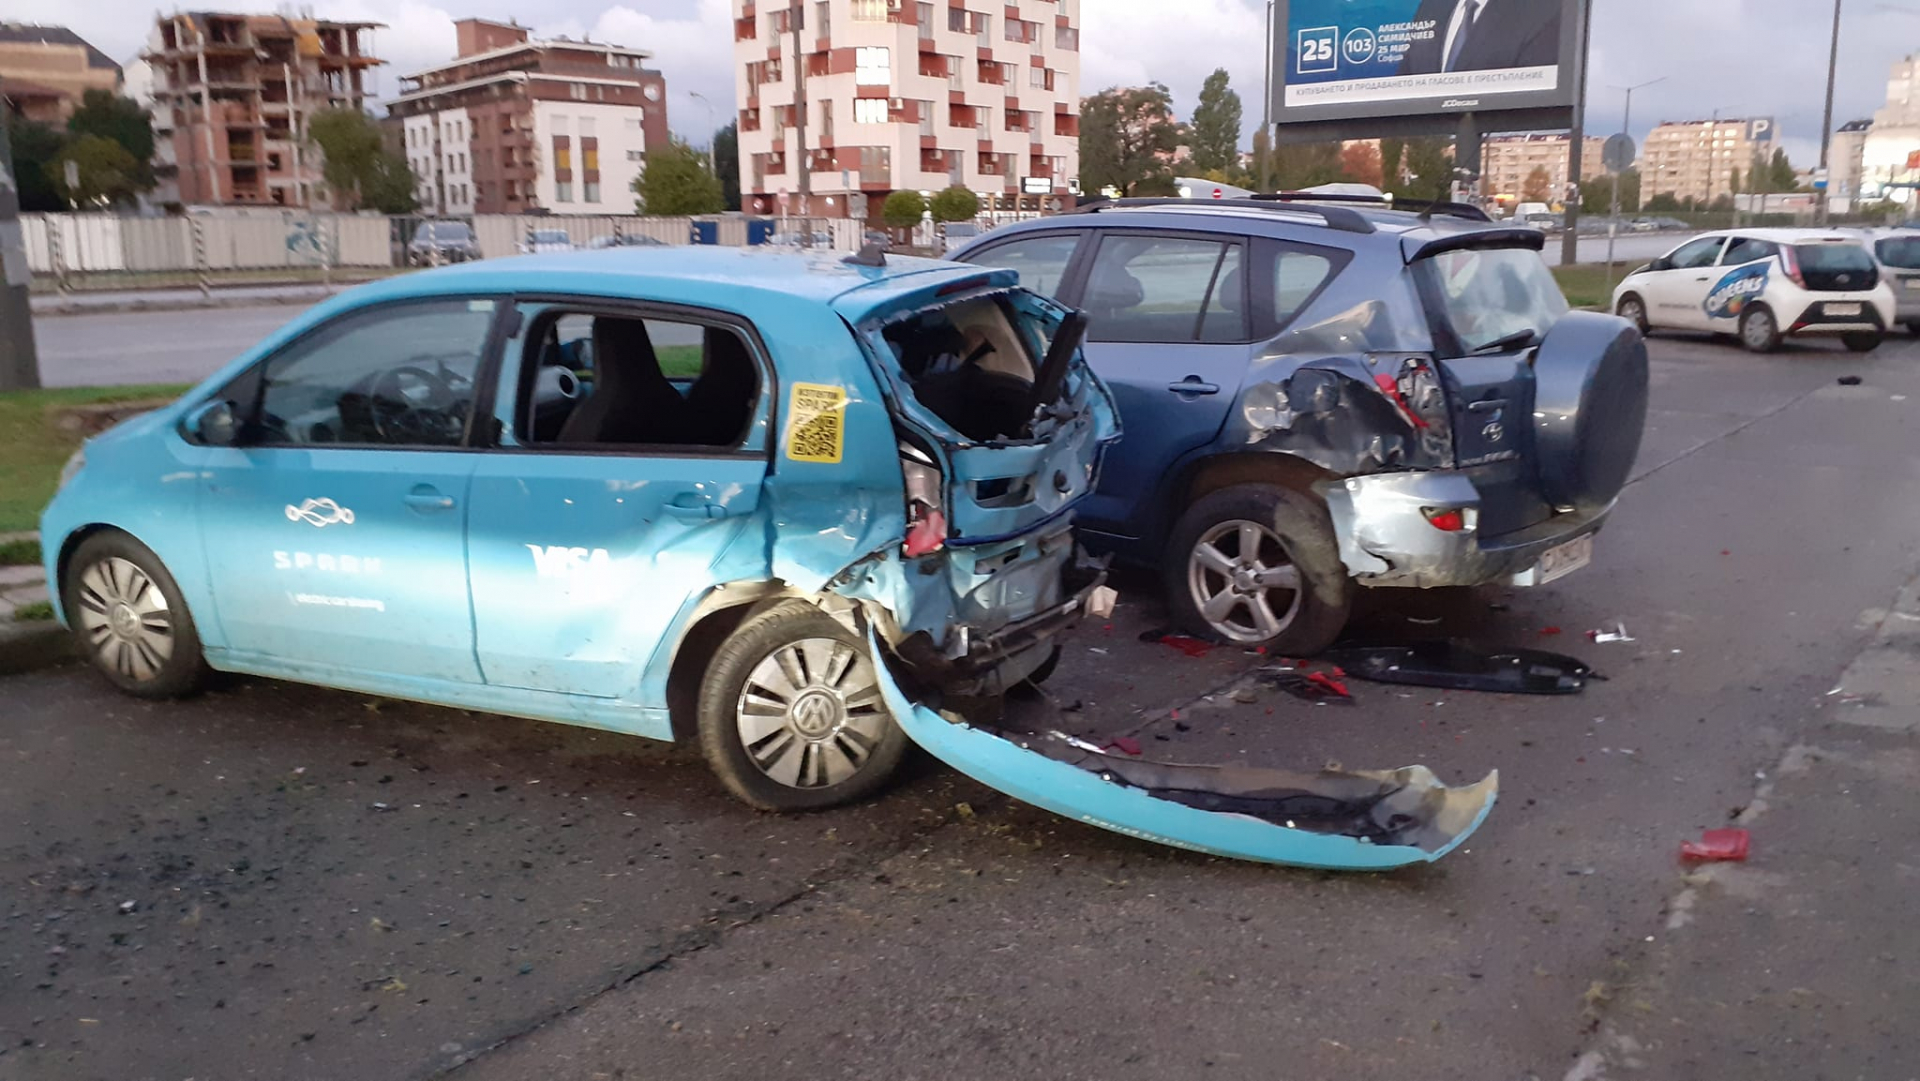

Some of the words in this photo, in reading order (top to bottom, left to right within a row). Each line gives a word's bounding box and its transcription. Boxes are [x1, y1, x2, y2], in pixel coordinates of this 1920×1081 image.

[1378, 20, 1436, 33] АЛЕКСАНДЪР
[1302, 38, 1332, 61] 25
[1346, 38, 1372, 53] 103
[1378, 45, 1388, 54] 25
[1378, 53, 1404, 63] София
[1296, 85, 1345, 96] КУПУВАНЕТО
[1355, 79, 1413, 90] ПРОДАВАНЕТО
[1429, 76, 1465, 85] ГЛАСОВЕ
[1474, 71, 1544, 82] ПРЕСТЪПЛЕНИЕ
[1752, 119, 1769, 139] P
[1707, 276, 1764, 312] QUEENS
[273, 550, 382, 573] SPARK
[525, 543, 613, 577] VISA
